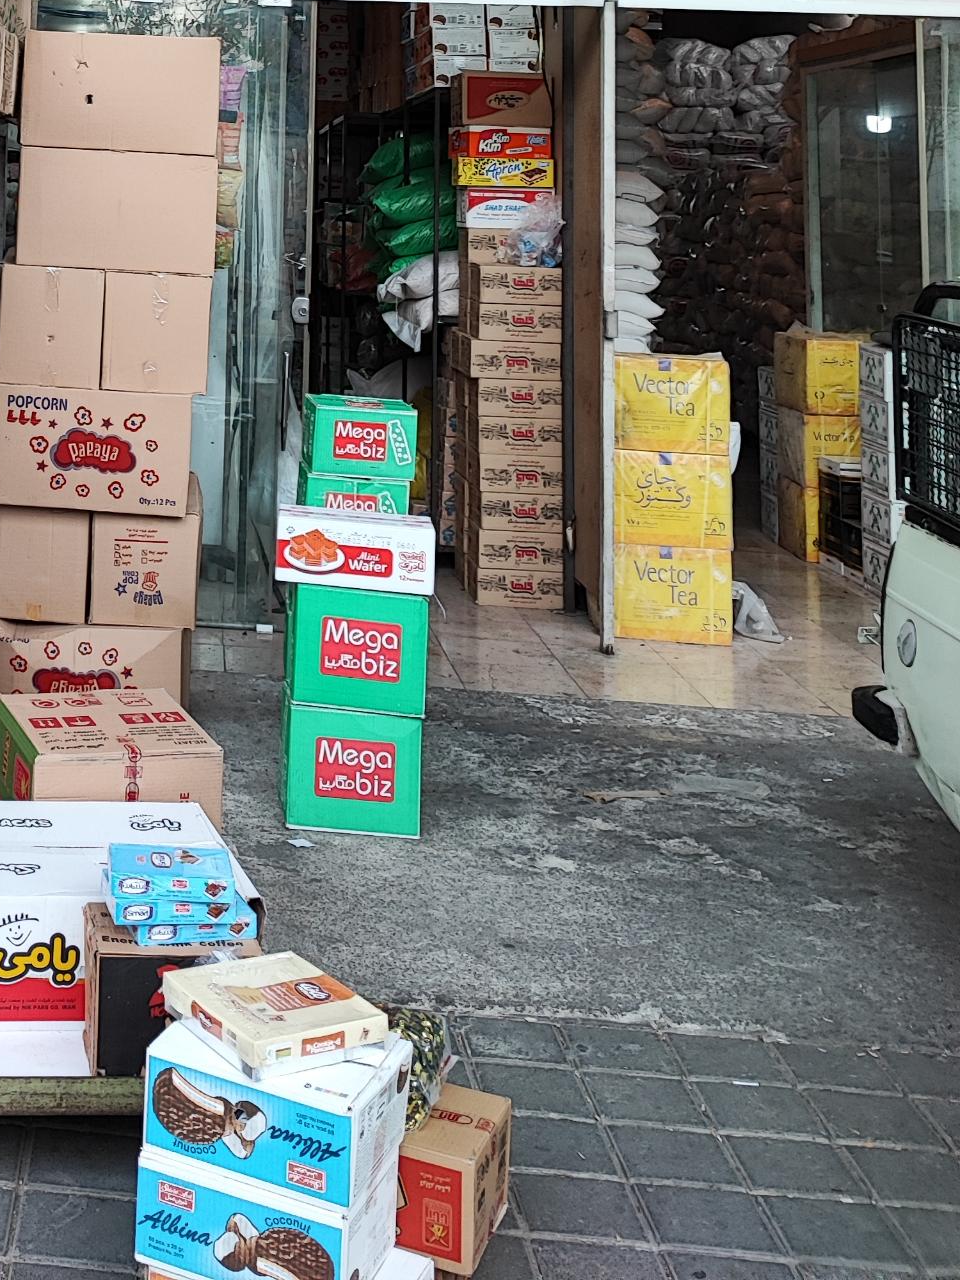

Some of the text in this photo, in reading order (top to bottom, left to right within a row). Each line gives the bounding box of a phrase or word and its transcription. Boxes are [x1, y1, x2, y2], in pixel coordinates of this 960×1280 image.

[479, 138, 502, 153] Kim
[633, 372, 693, 396] Vector
[7, 394, 68, 412] POPCORN
[666, 395, 695, 417] Tea
[335, 422, 385, 442] Mega
[360, 441, 385, 458] biz
[635, 468, 676, 490] چای
[634, 487, 692, 509] وکتور
[348, 558, 388, 573] Wafer
[356, 551, 381, 561] Mini
[122, 576, 139, 585] POP
[633, 559, 695, 584] Vector
[668, 583, 699, 607] Tea
[324, 619, 399, 651] Mega
[359, 652, 399, 679] biz
[317, 739, 392, 770] Mega
[354, 769, 392, 798] biz
[171, 1136, 217, 1156] Coconut
[266, 1125, 348, 1163] Albina
[138, 1209, 213, 1247] Albina
[264, 1216, 312, 1236] Coconut
